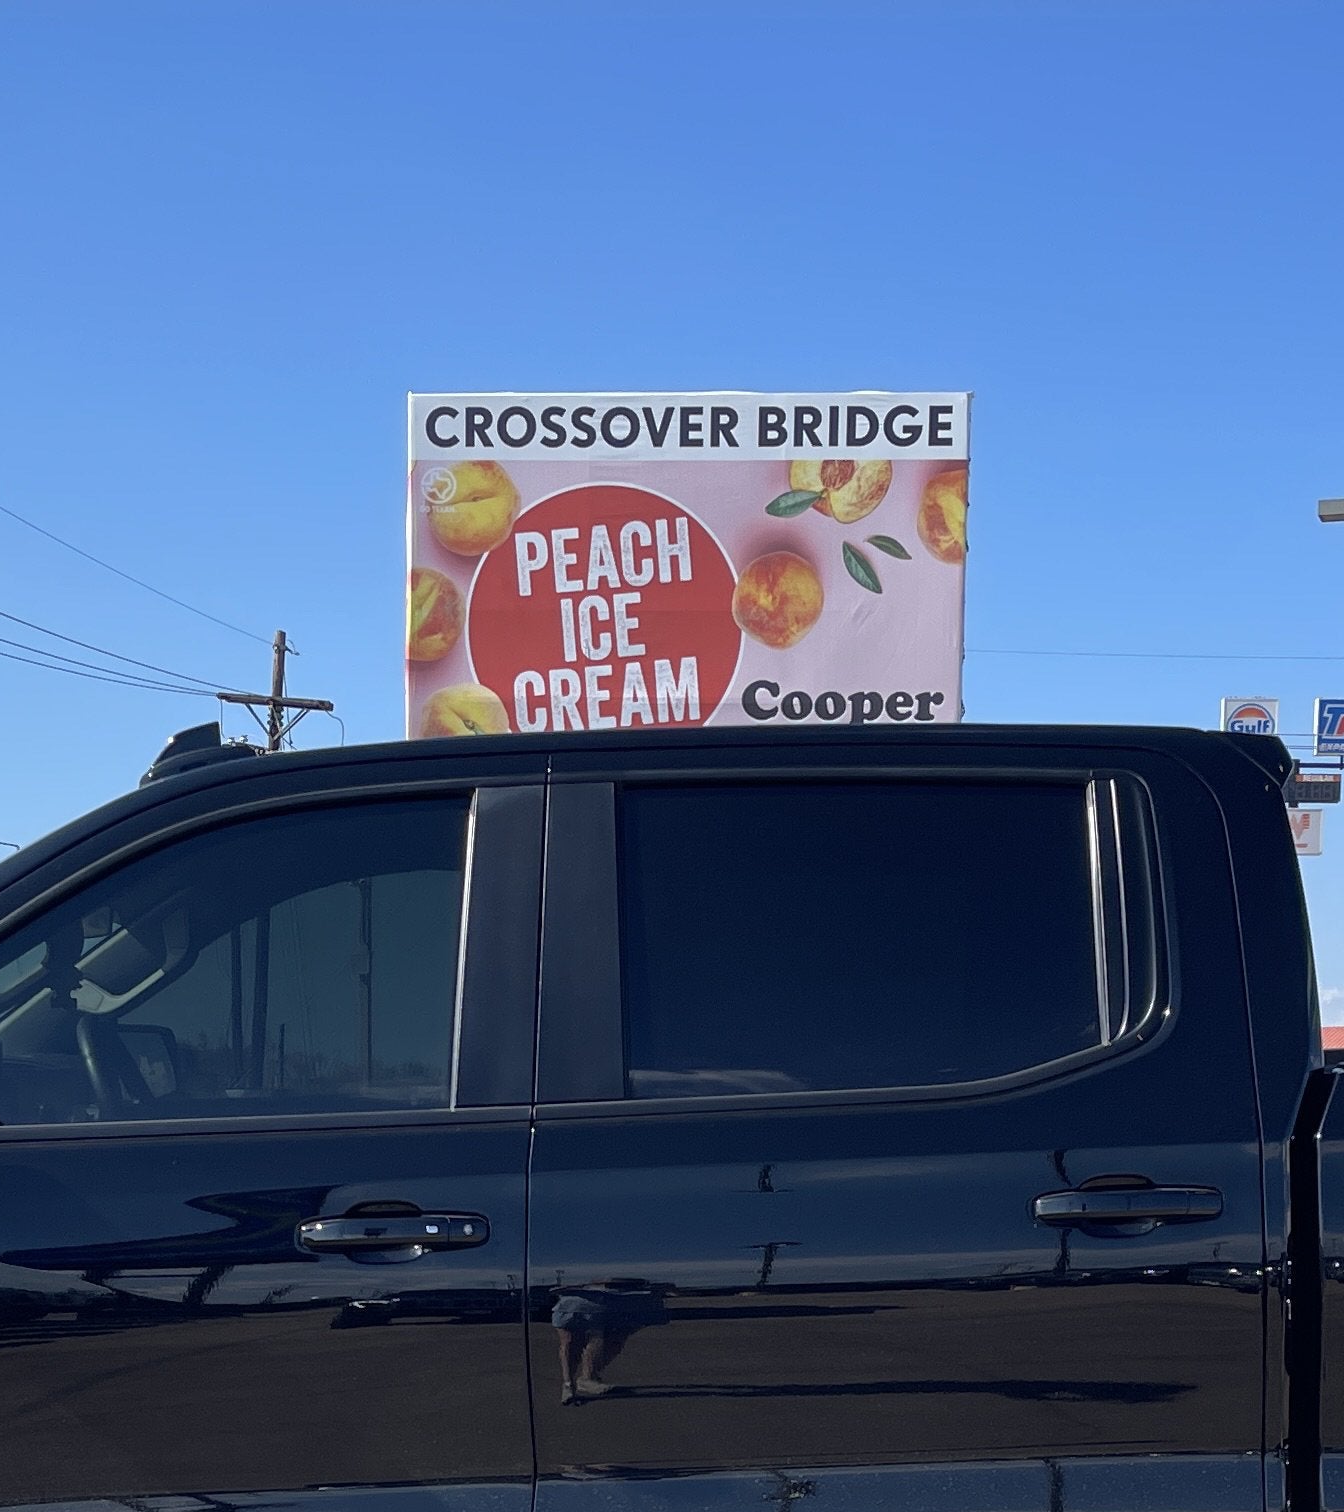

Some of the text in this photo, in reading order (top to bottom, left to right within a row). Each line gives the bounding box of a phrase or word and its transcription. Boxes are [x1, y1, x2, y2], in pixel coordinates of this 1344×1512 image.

[425, 404, 954, 449] CROSSOVER BRIDGE
[514, 516, 693, 597] PEACH
[560, 591, 646, 662] ICE
[513, 655, 702, 734] CREAM
[741, 679, 945, 726] Cooper
[1230, 719, 1270, 734] Gulf
